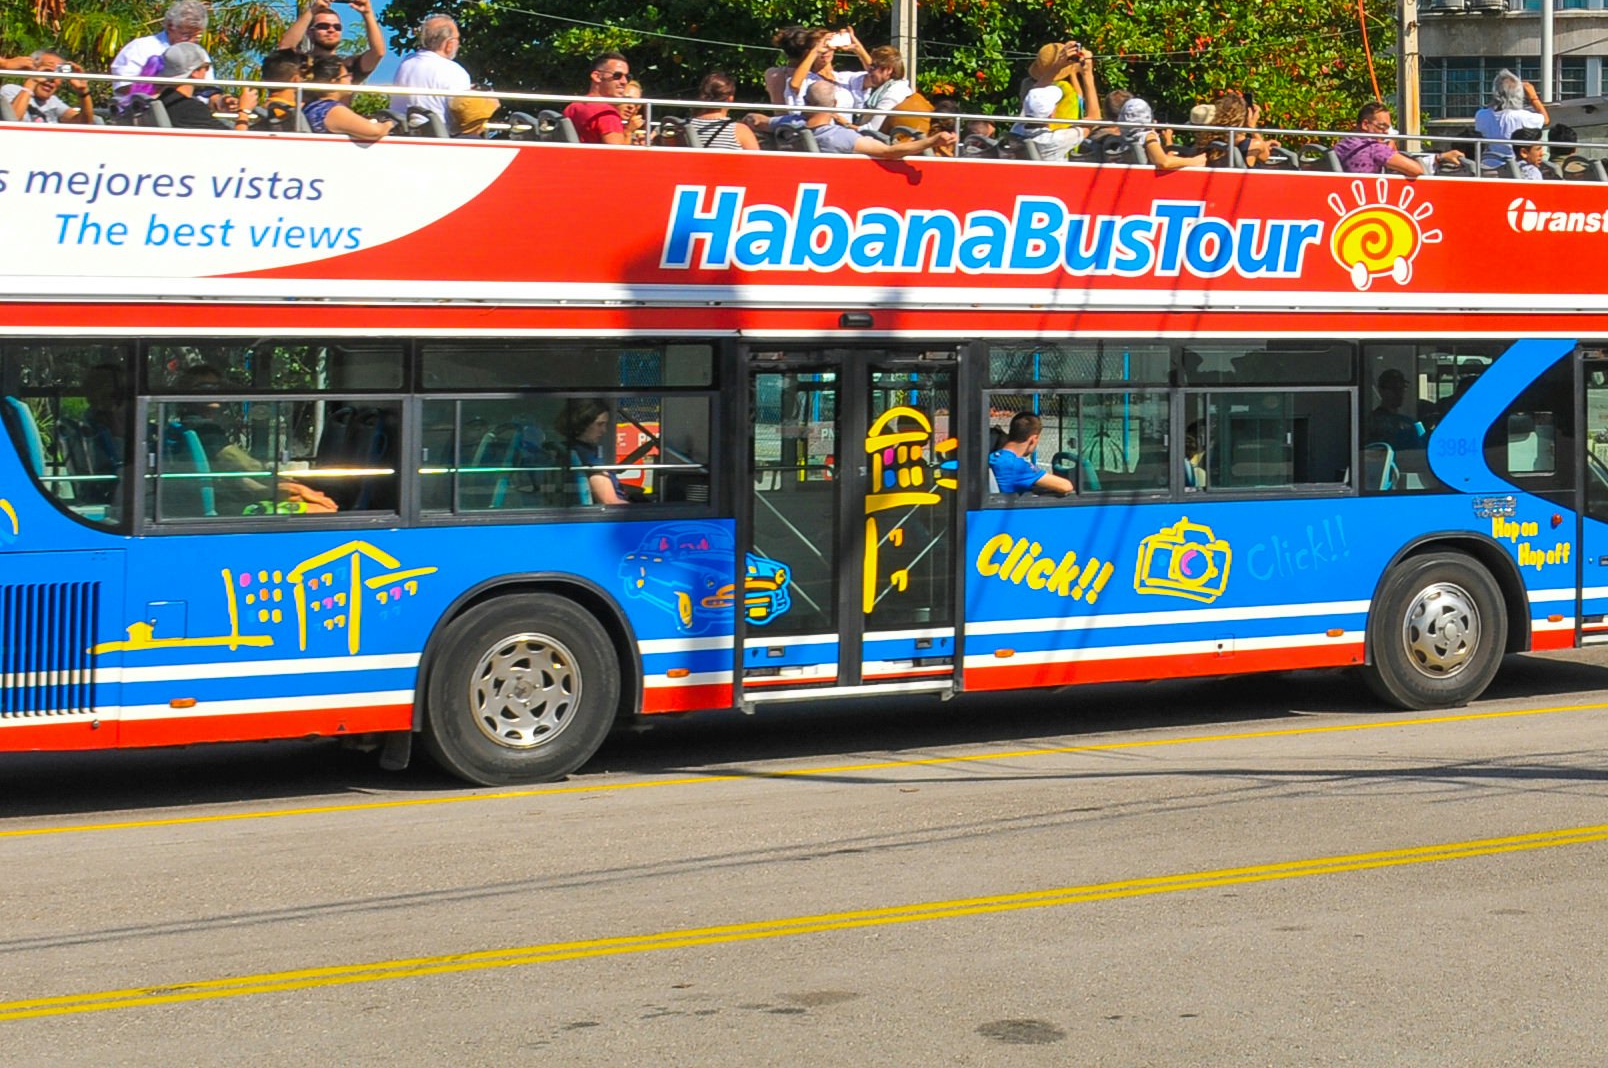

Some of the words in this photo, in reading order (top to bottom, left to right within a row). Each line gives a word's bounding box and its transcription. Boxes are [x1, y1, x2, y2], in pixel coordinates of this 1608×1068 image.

[24, 163, 196, 205] mejores
[210, 168, 325, 202] vistas
[55, 212, 128, 246] The
[144, 213, 236, 248] best
[249, 216, 363, 250] views
[659, 182, 1321, 279] HabanaBusTour
[1436, 437, 1479, 458] 3984
[1246, 514, 1351, 582] Click!!
[1491, 516, 1520, 543] Hop
[1521, 521, 1539, 537] on
[976, 533, 1115, 605] Click!!
[1517, 542, 1546, 571] Hop
[1546, 541, 1571, 564] off
